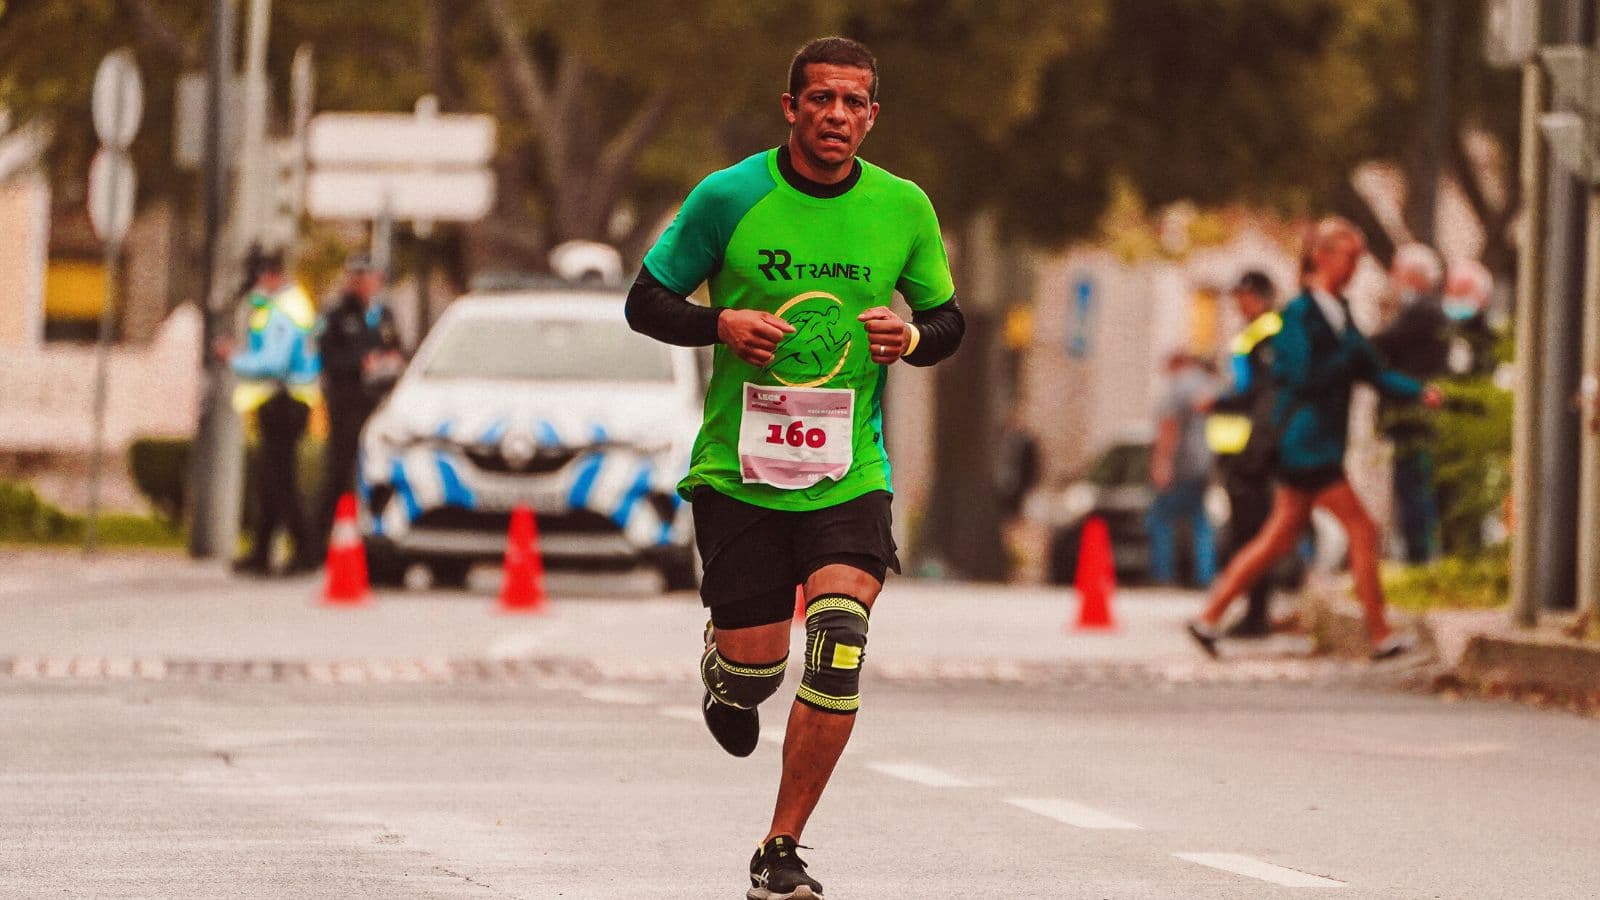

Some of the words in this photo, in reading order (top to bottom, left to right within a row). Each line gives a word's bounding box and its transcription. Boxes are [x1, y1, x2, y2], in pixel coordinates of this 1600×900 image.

[758, 249, 793, 281] RR
[794, 262, 871, 283] TRAINER
[766, 420, 827, 448] 160
